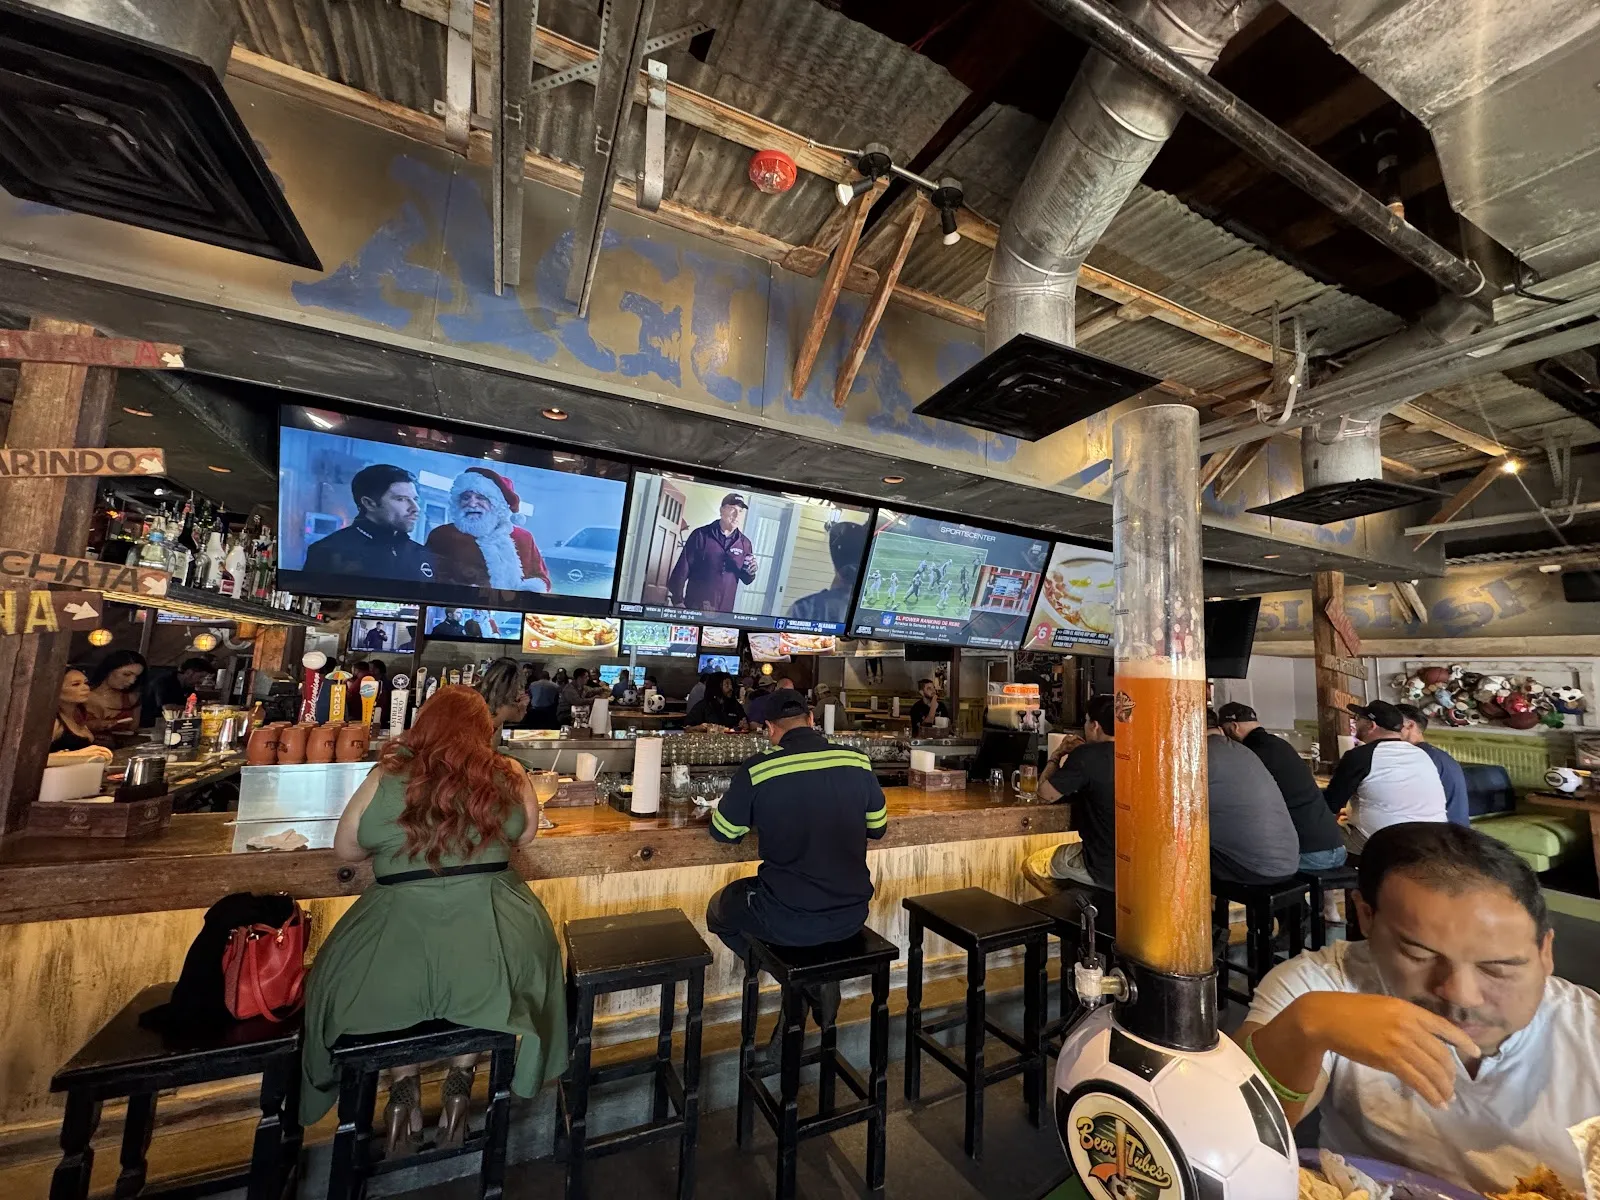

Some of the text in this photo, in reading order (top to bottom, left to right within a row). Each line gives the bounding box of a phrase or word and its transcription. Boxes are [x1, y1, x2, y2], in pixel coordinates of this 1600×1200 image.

[940, 526, 997, 543] SPORTSCENTER
[333, 685, 342, 716] MANGO
[390, 697, 399, 728] ESTRELLA
[1076, 1116, 1173, 1189] Beer Tubes
